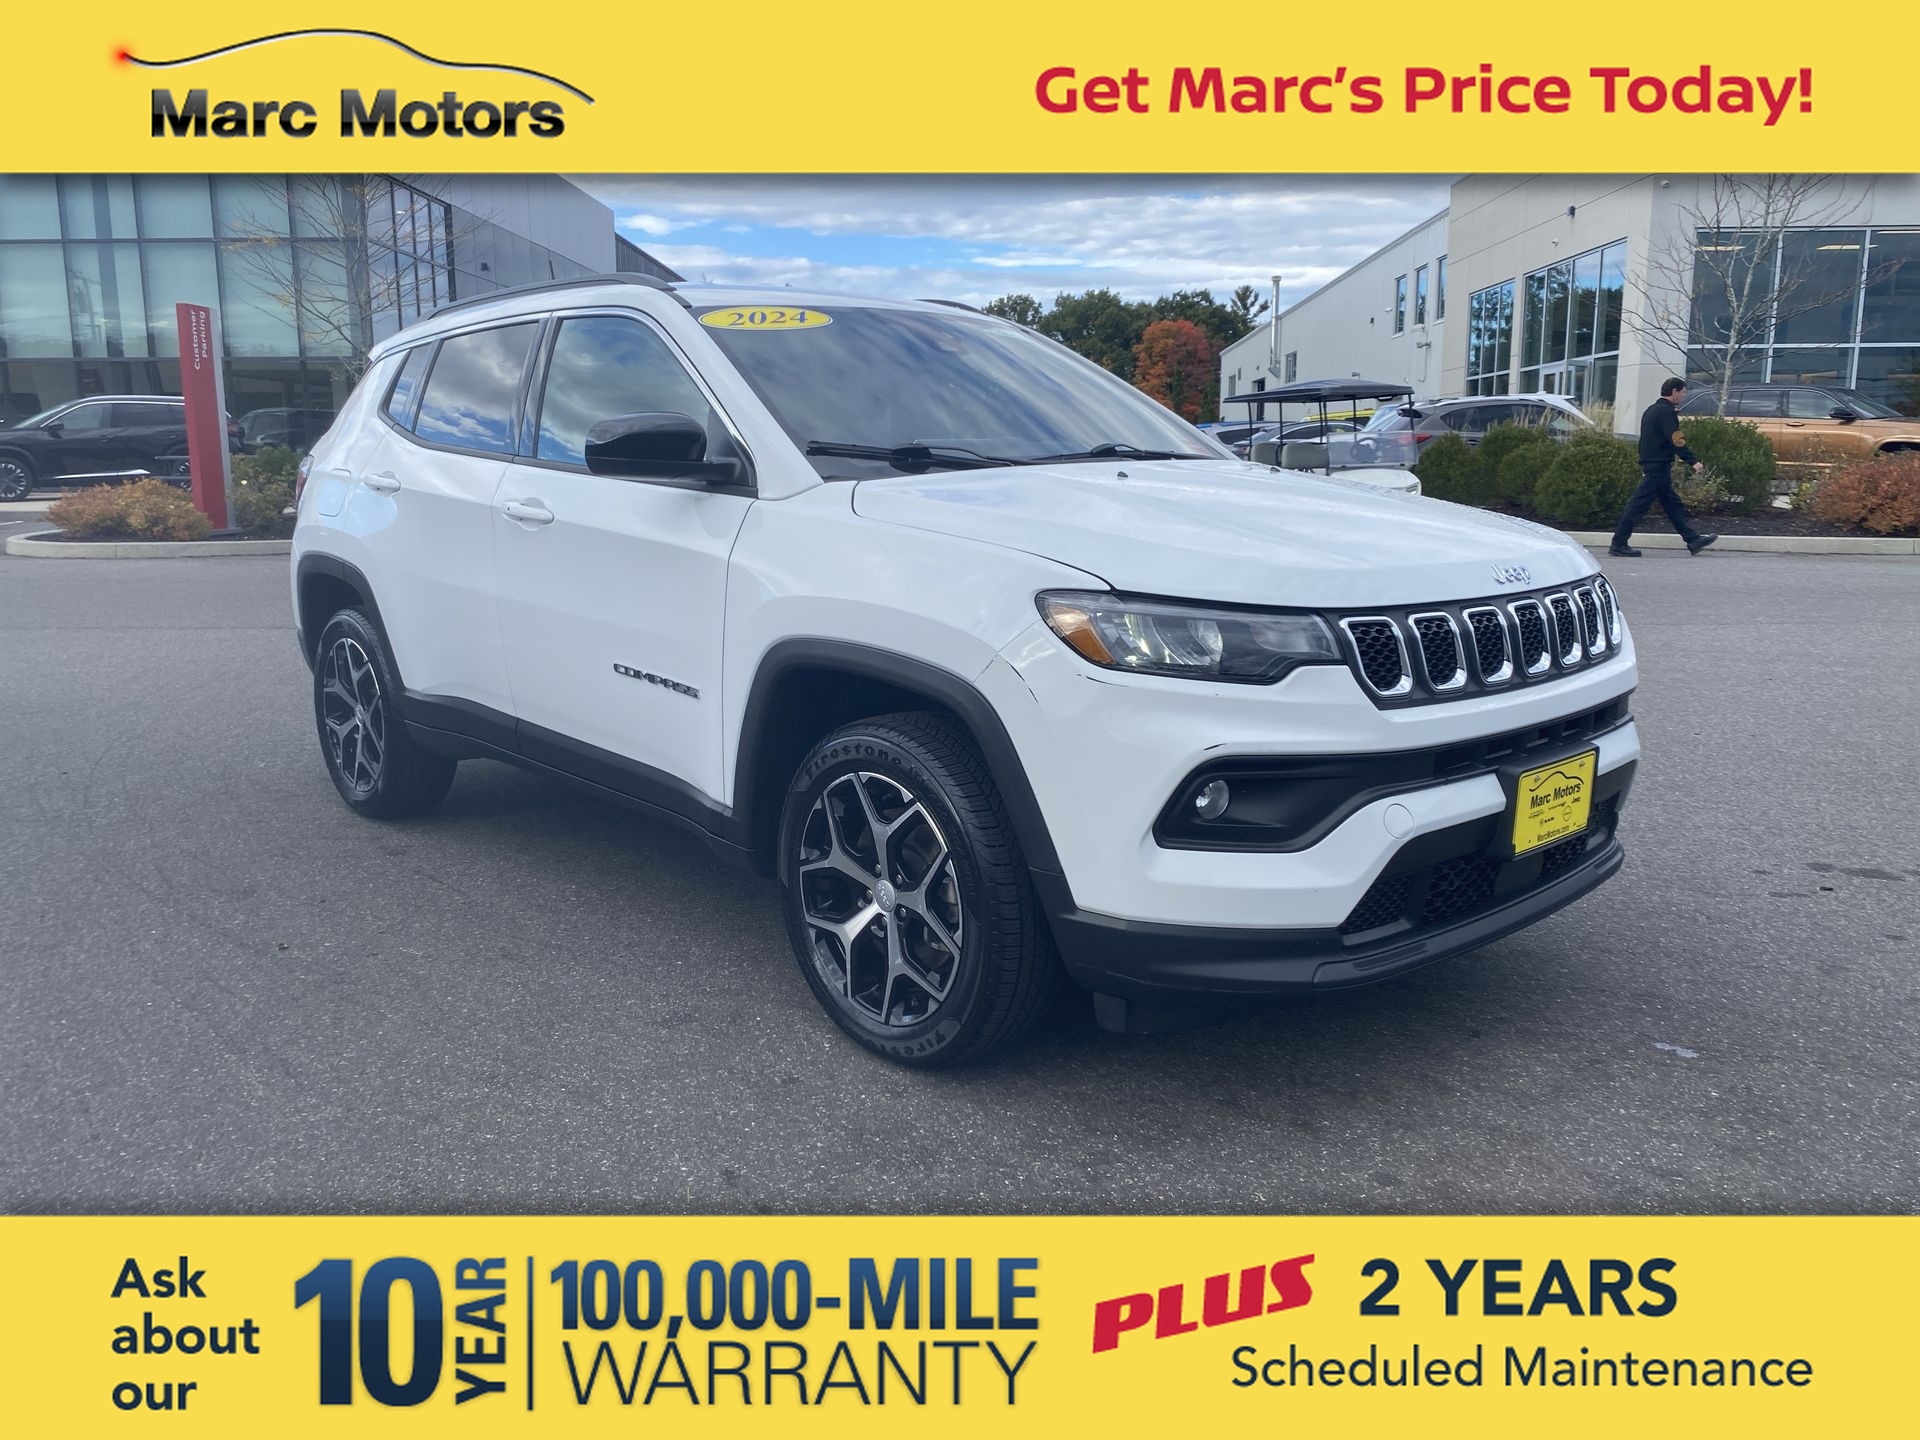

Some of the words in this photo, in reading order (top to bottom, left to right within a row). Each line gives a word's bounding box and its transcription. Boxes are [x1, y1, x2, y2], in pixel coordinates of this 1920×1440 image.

[199, 311, 208, 358] Parking
[727, 311, 808, 326] 2024
[190, 310, 200, 370] Customer
[1490, 564, 1531, 585] Jeep
[613, 663, 700, 700] COMPASS
[805, 743, 902, 781] Firestone
[1530, 794, 1551, 809] Marc
[1553, 783, 1581, 801] Motors
